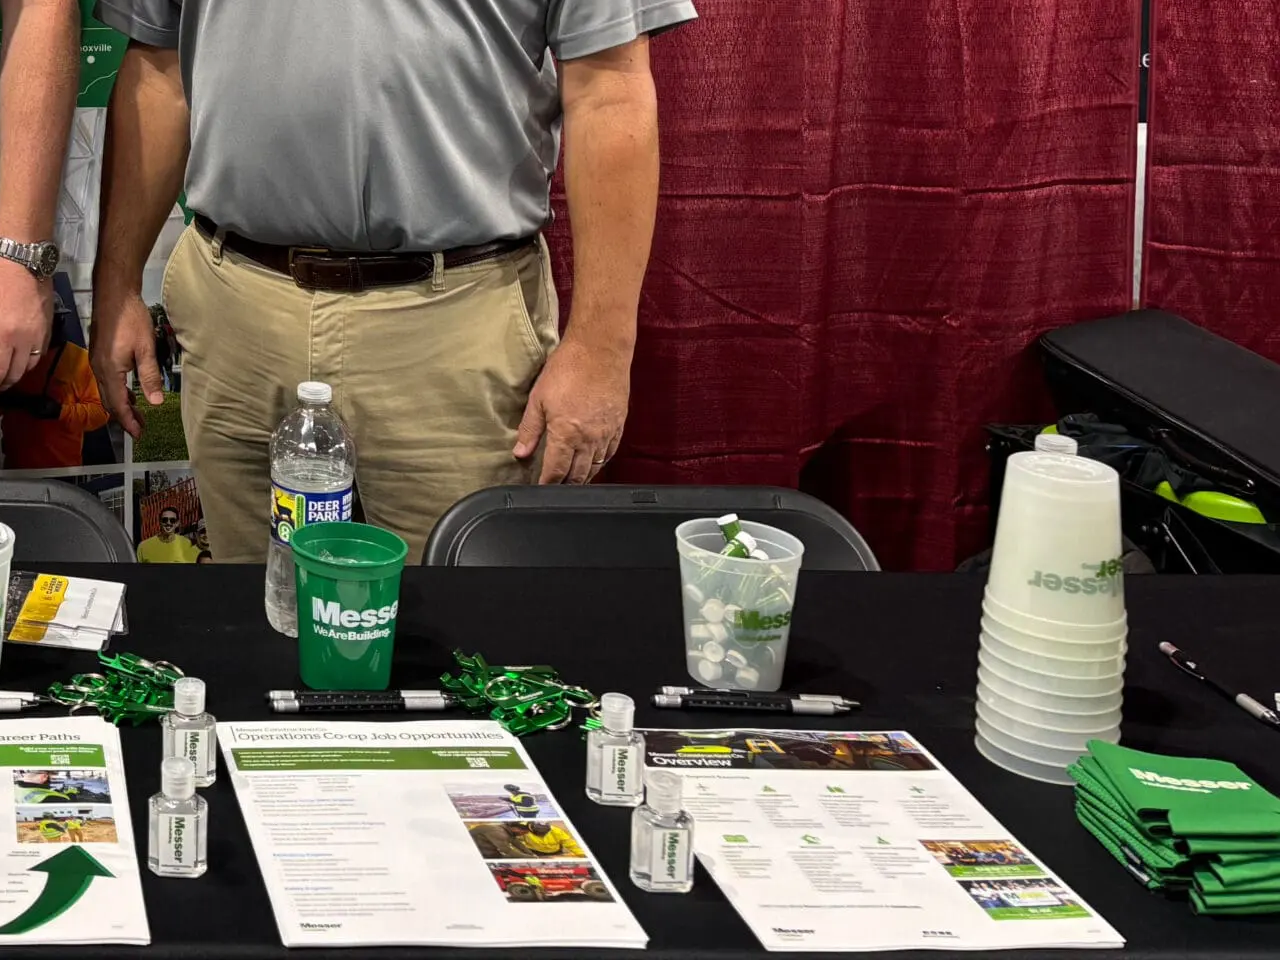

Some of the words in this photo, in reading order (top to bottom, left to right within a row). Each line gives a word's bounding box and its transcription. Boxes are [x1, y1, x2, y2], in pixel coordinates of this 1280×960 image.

[308, 500, 340, 512] DEER
[308, 511, 340, 522] PARK
[40, 733, 81, 741] Paths
[238, 732, 321, 742] Operations
[323, 732, 367, 741] Co-op
[371, 732, 397, 740] Job
[399, 732, 504, 741] Opportunities
[652, 757, 732, 767] Overview
[173, 816, 185, 864] Messer
[667, 832, 679, 880] Messer
